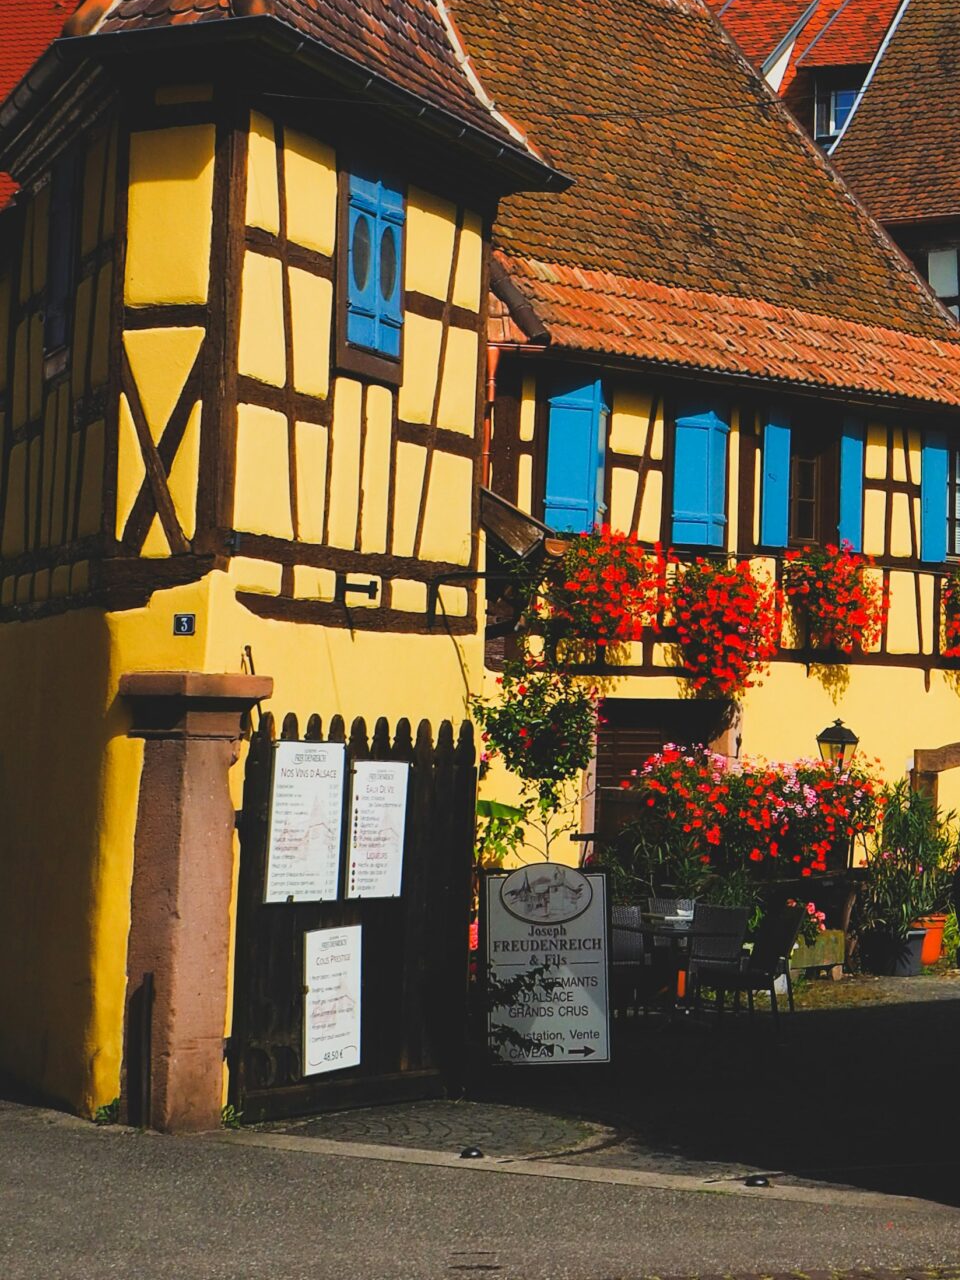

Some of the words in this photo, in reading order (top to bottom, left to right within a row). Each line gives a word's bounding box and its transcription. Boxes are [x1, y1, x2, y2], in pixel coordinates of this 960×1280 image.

[180, 617, 188, 632] 3
[528, 924, 567, 938] Joseph
[493, 938, 602, 952] FREUDENREICH
[529, 954, 539, 966] &
[544, 953, 567, 966] Fils
[508, 1006, 554, 1018] GRANDS
[558, 1005, 589, 1017] CRUS
[569, 1029, 600, 1040] Vente
